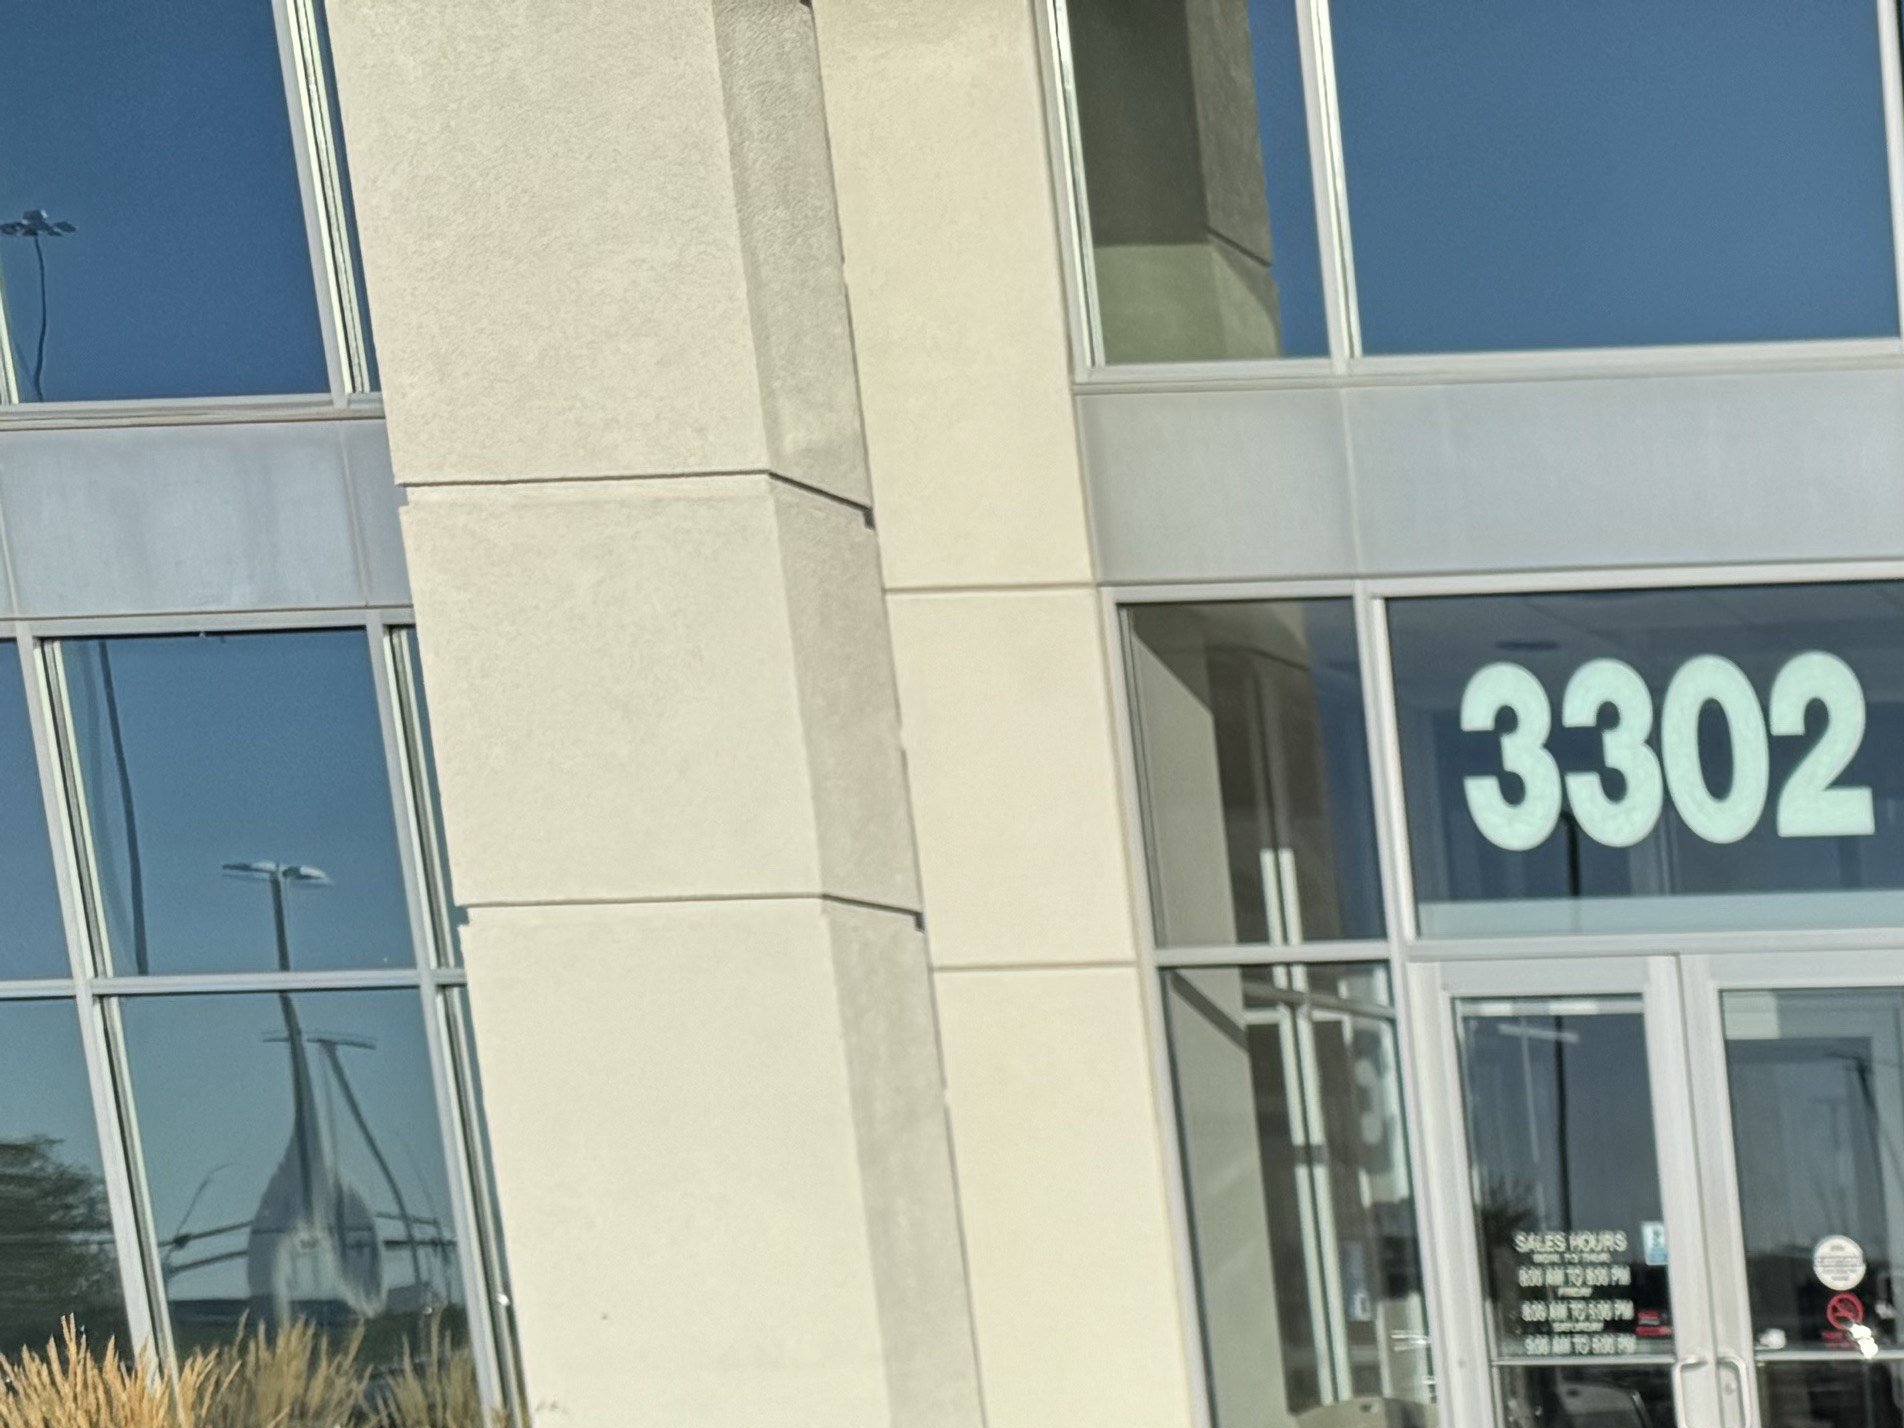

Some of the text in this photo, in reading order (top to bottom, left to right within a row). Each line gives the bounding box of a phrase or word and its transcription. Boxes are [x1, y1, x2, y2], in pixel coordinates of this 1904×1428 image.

[1460, 650, 1875, 851] 3302
[1514, 1231, 1628, 1252] SALES HOURS
